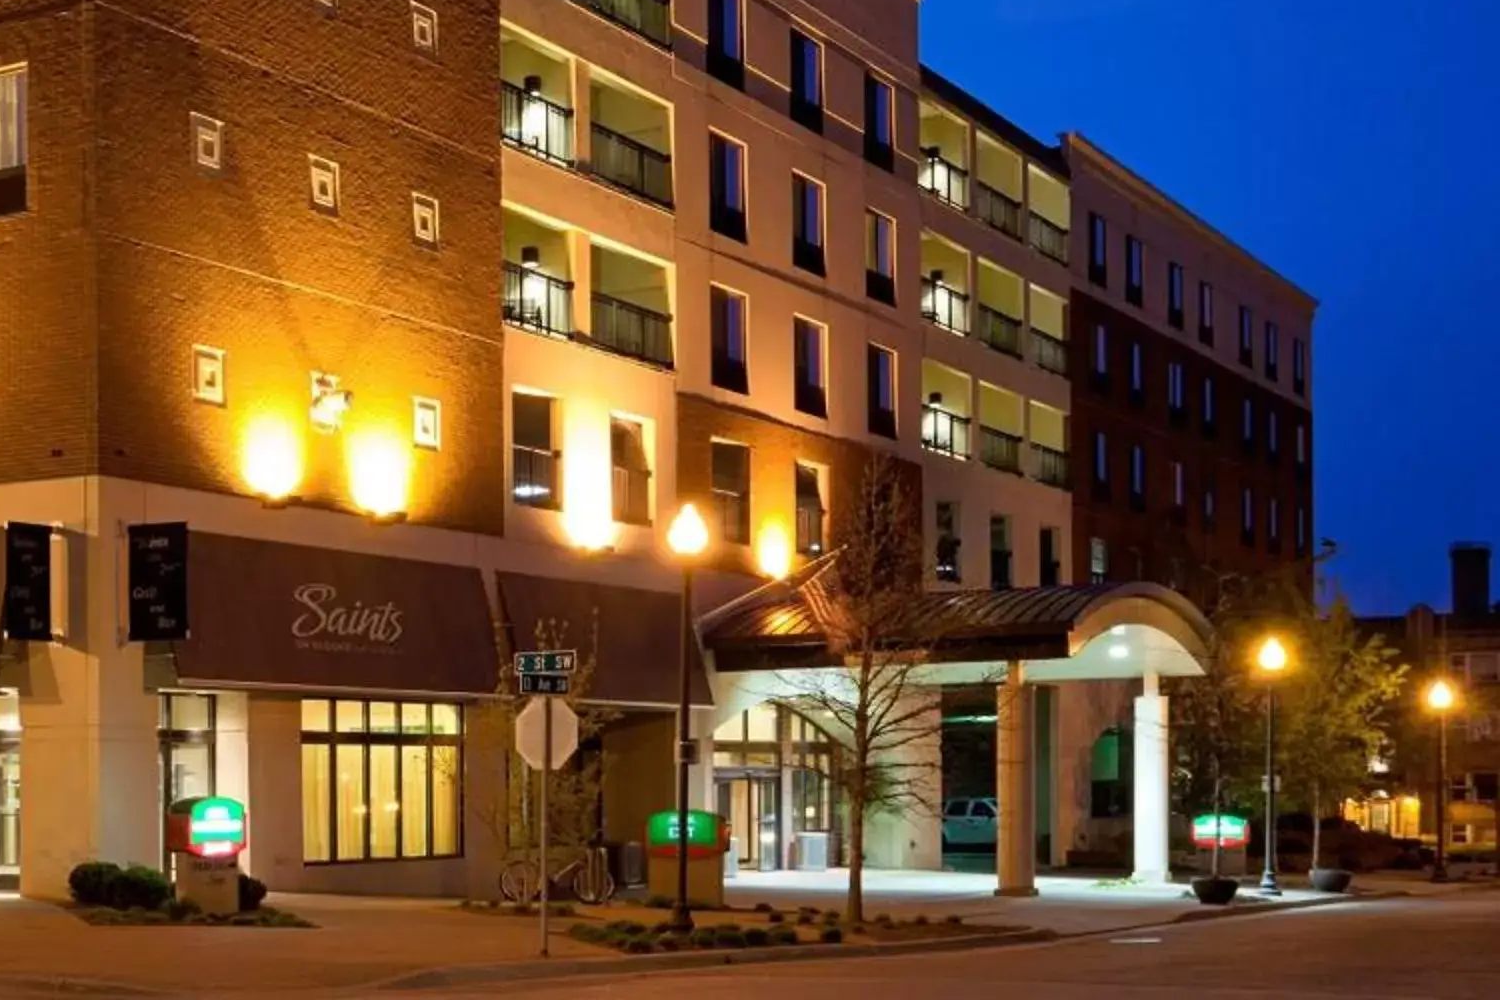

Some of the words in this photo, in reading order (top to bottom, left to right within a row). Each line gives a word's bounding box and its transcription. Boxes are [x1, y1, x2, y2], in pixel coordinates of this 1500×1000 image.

[291, 583, 404, 643] Saints
[517, 657, 525, 670] 2
[555, 655, 572, 668] SW
